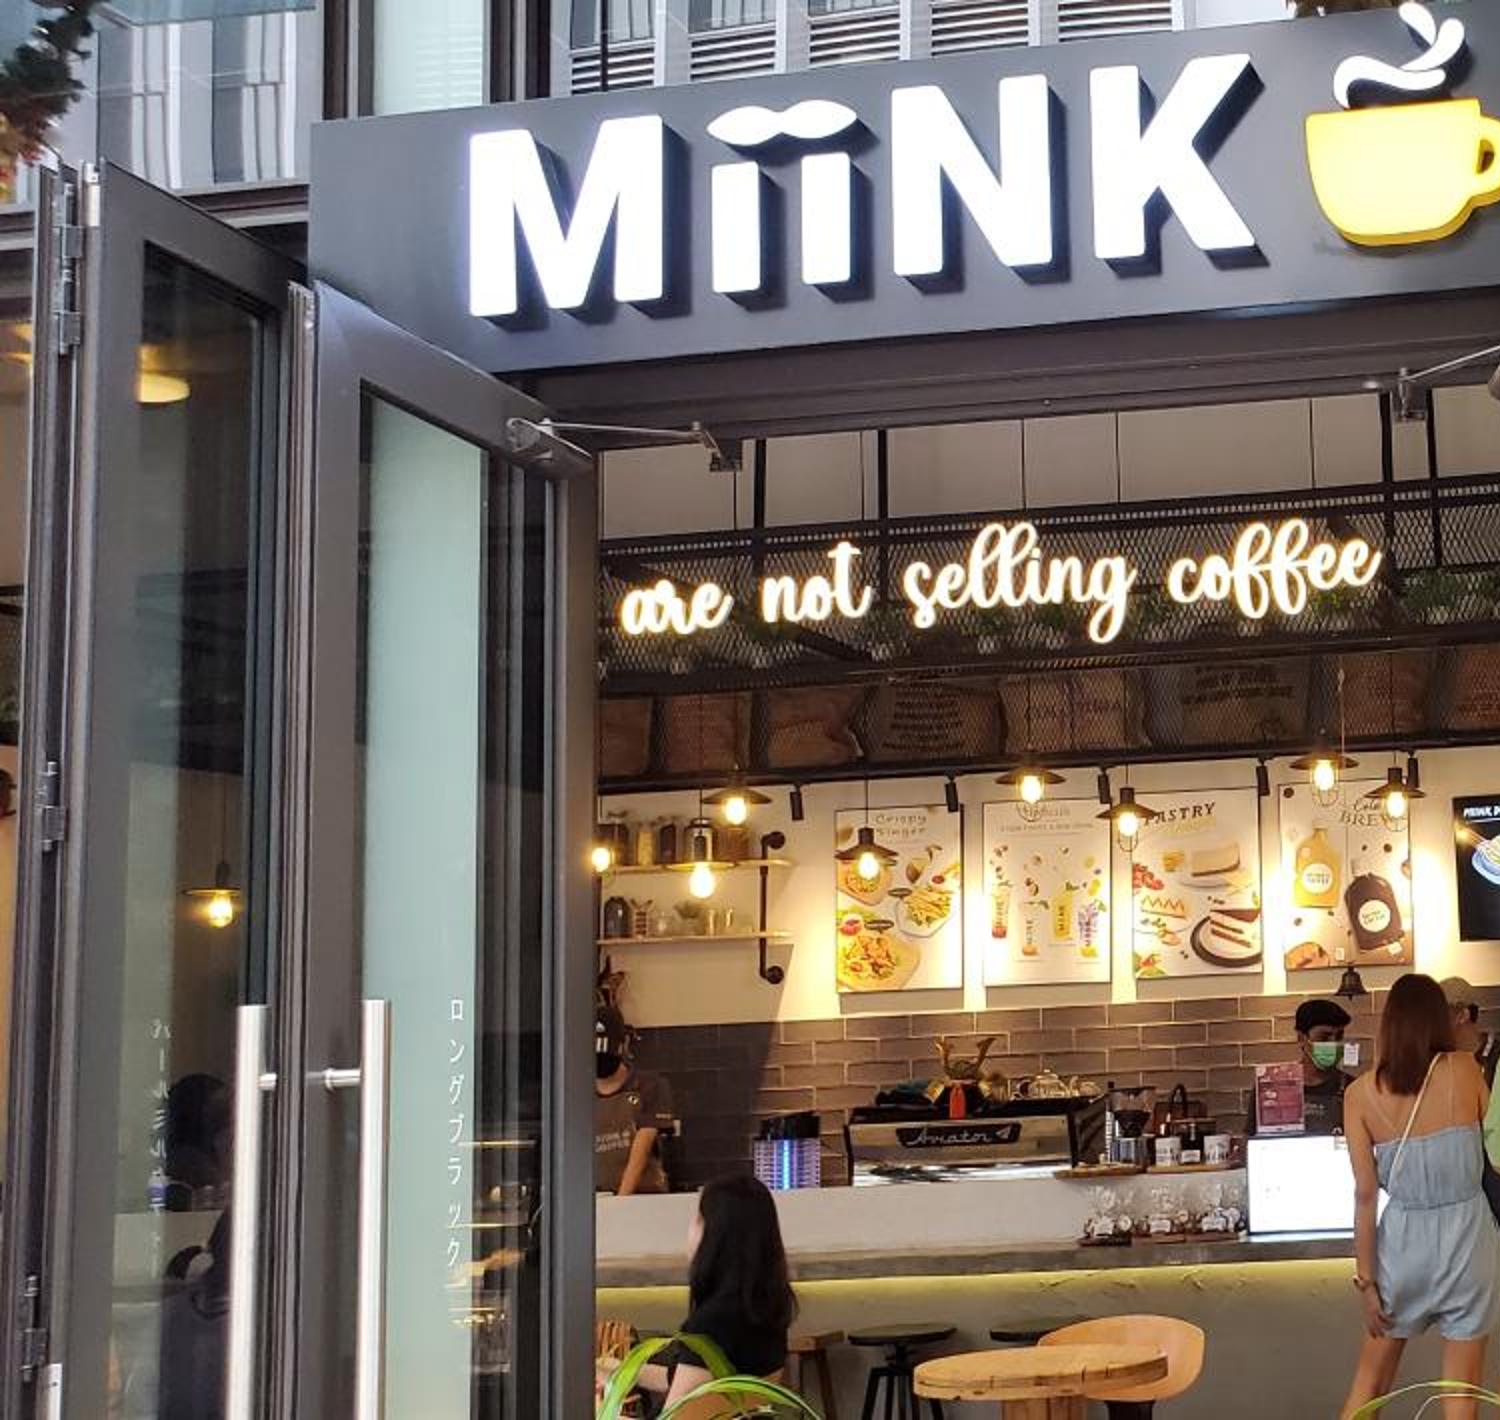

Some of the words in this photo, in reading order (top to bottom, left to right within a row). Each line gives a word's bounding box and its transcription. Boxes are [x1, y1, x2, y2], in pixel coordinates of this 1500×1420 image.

[620, 578, 733, 636] are
[761, 540, 873, 624] not
[903, 521, 1138, 644] selling
[1167, 517, 1382, 621] coffee
